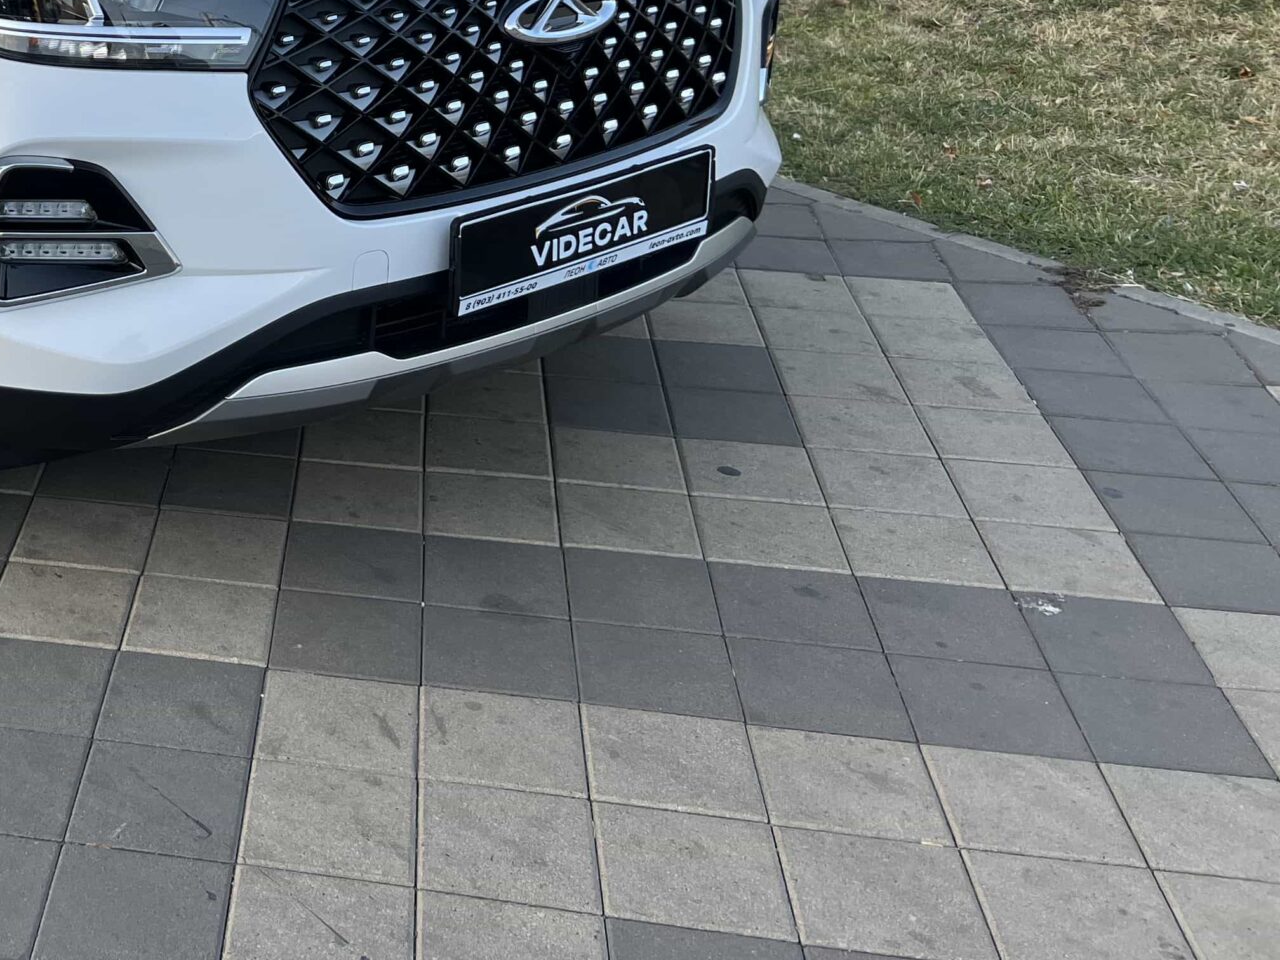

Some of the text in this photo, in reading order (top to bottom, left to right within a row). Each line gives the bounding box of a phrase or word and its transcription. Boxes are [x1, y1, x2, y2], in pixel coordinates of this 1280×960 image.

[530, 210, 649, 267] VIDECAR
[597, 254, 618, 267] АВТО
[465, 303, 472, 311] 8
[472, 294, 495, 310] (903)
